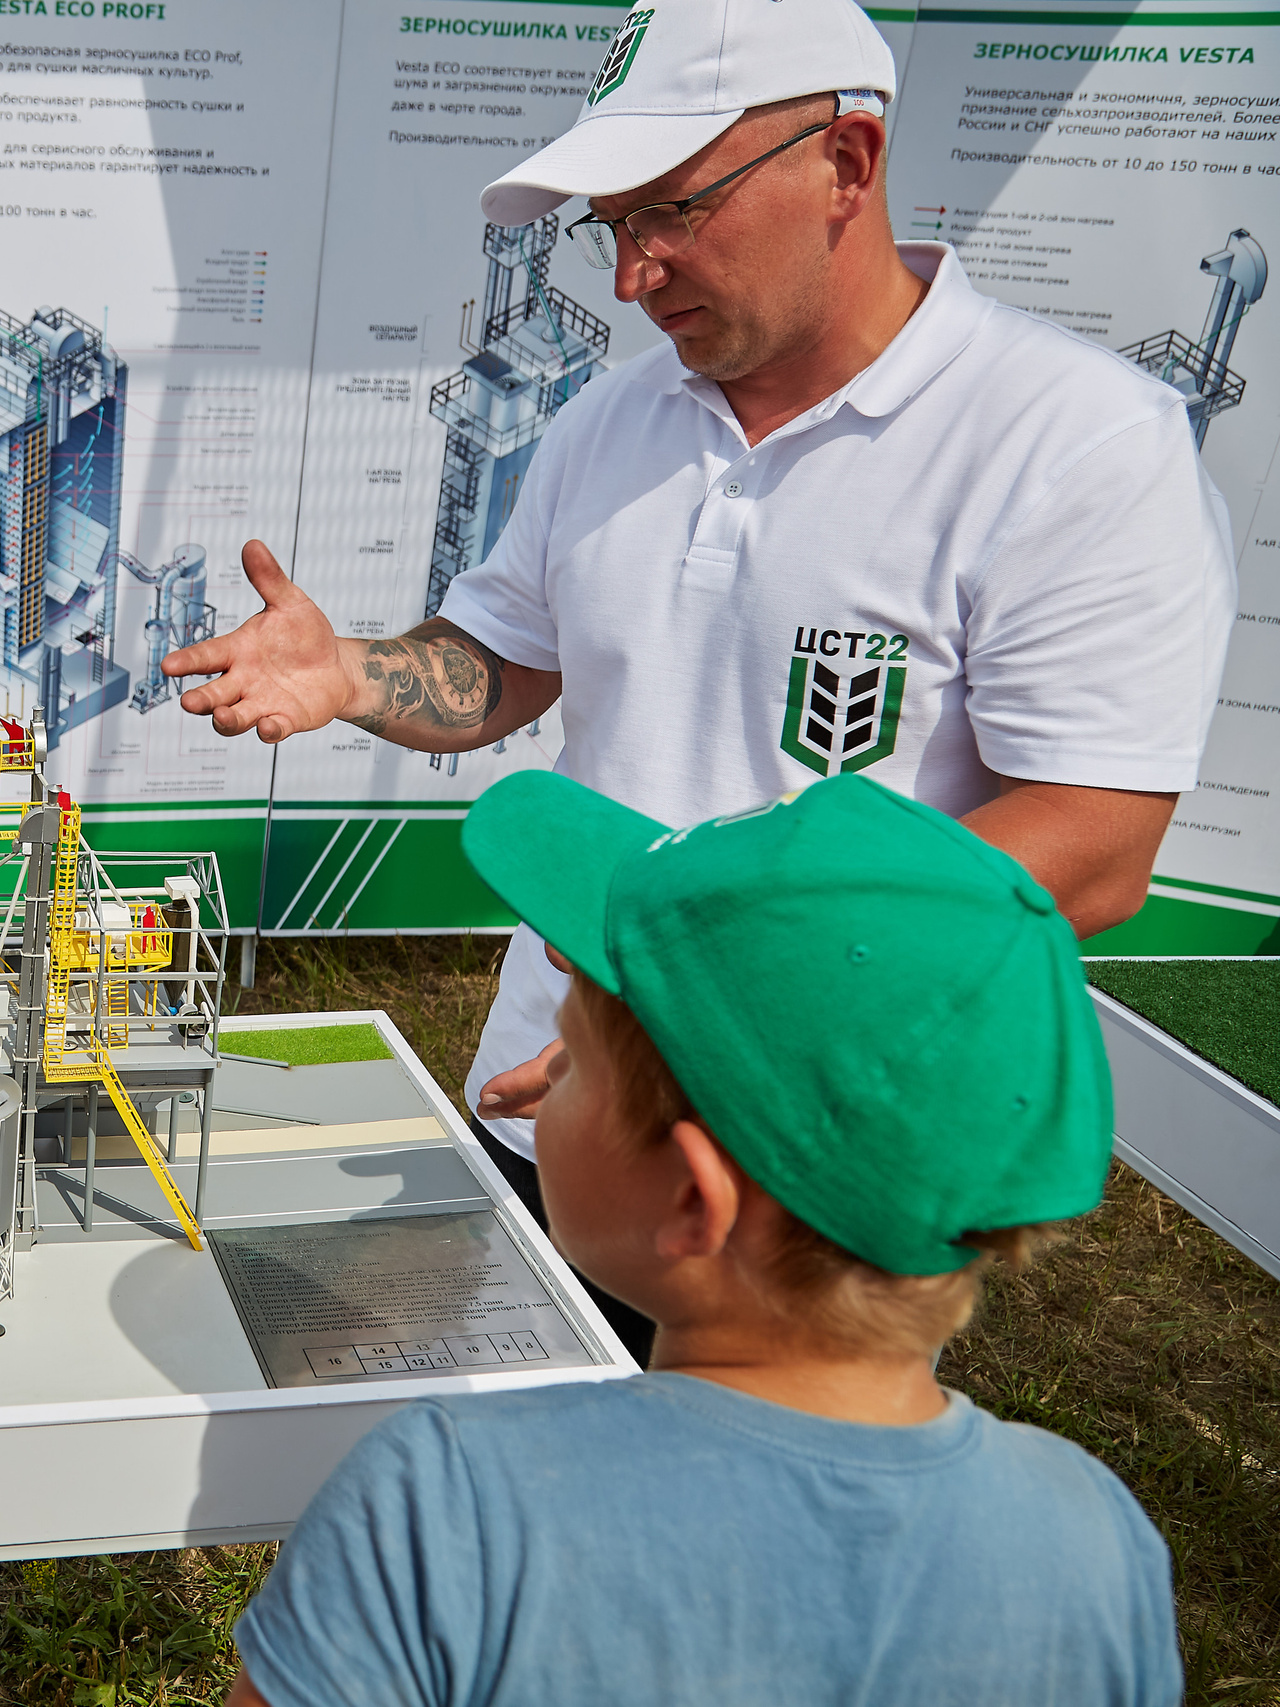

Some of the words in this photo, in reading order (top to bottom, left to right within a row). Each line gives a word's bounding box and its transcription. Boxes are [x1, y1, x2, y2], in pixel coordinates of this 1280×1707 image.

[56, 2, 95, 17] ECO
[103, 2, 165, 20] PROFI
[400, 17, 567, 40] ЗЕРНОСУШИЛКА
[616, 8, 656, 36] СТ22
[86, 48, 179, 62] зерносушилка
[184, 49, 211, 63] ECO
[974, 44, 1167, 62] ЗЕРНОСУШИЛКА
[1180, 48, 1254, 63] VESTA
[7, 62, 31, 73] для
[36, 63, 77, 74] сушки
[82, 65, 153, 76] масличных
[159, 67, 213, 80] культур.
[397, 61, 429, 73] Vesta
[434, 62, 460, 75] ECO
[464, 65, 551, 79] соответствует
[557, 70, 586, 79] всем
[395, 79, 428, 90] шума
[433, 81, 440, 89] и
[445, 80, 526, 94] загрязнению
[964, 86, 1073, 101] Универсальная
[1079, 92, 1088, 101] и
[1193, 96, 1280, 109] зерносуши
[90, 98, 187, 110] равномерность
[192, 101, 232, 113] сушки
[392, 101, 424, 112] даже
[429, 103, 435, 112] в
[441, 104, 475, 115] черте
[480, 105, 526, 117] города.
[18, 112, 81, 124] продукта.
[961, 104, 1036, 118] признание
[1042, 105, 1225, 123] сельхозпроизводителей.
[1234, 112, 1280, 124] Более
[958, 117, 1006, 130] России
[1011, 123, 1019, 131] и
[1025, 121, 1053, 133] СНГ
[1058, 125, 1120, 136] успешно
[1125, 126, 1196, 138] работают
[1202, 131, 1219, 140] на
[1225, 131, 1276, 141] наших
[389, 130, 518, 148] Производительность
[523, 138, 536, 148] от
[4, 144, 27, 154] для
[32, 144, 105, 156] сервисного
[110, 145, 202, 159] обслуживания
[207, 150, 214, 158] и
[20, 160, 95, 172] материалов
[101, 162, 177, 174] гарантирует
[184, 165, 257, 176] надежность
[262, 168, 269, 176] и
[951, 149, 1097, 168] Производительность
[1102, 159, 1117, 168] от
[1125, 158, 1141, 169] 10
[1145, 161, 1164, 171] до
[1171, 160, 1197, 172] 150
[1203, 164, 1237, 173] тонн
[1243, 165, 1251, 174] в
[0, 205, 21, 217] 100
[26, 208, 55, 217] тонн
[73, 209, 96, 218] час.
[1236, 614, 1256, 622] ОНА
[794, 626, 909, 661] ЦСТ22
[1226, 699, 1251, 709] ЗОНА
[371, 1347, 386, 1355] 14
[465, 1345, 480, 1354] 10
[503, 1342, 511, 1352] 9
[525, 1341, 534, 1350] 8
[327, 1357, 342, 1366] 16
[378, 1361, 393, 1370] 15
[412, 1358, 426, 1366] 12
[436, 1356, 450, 1365] 11
